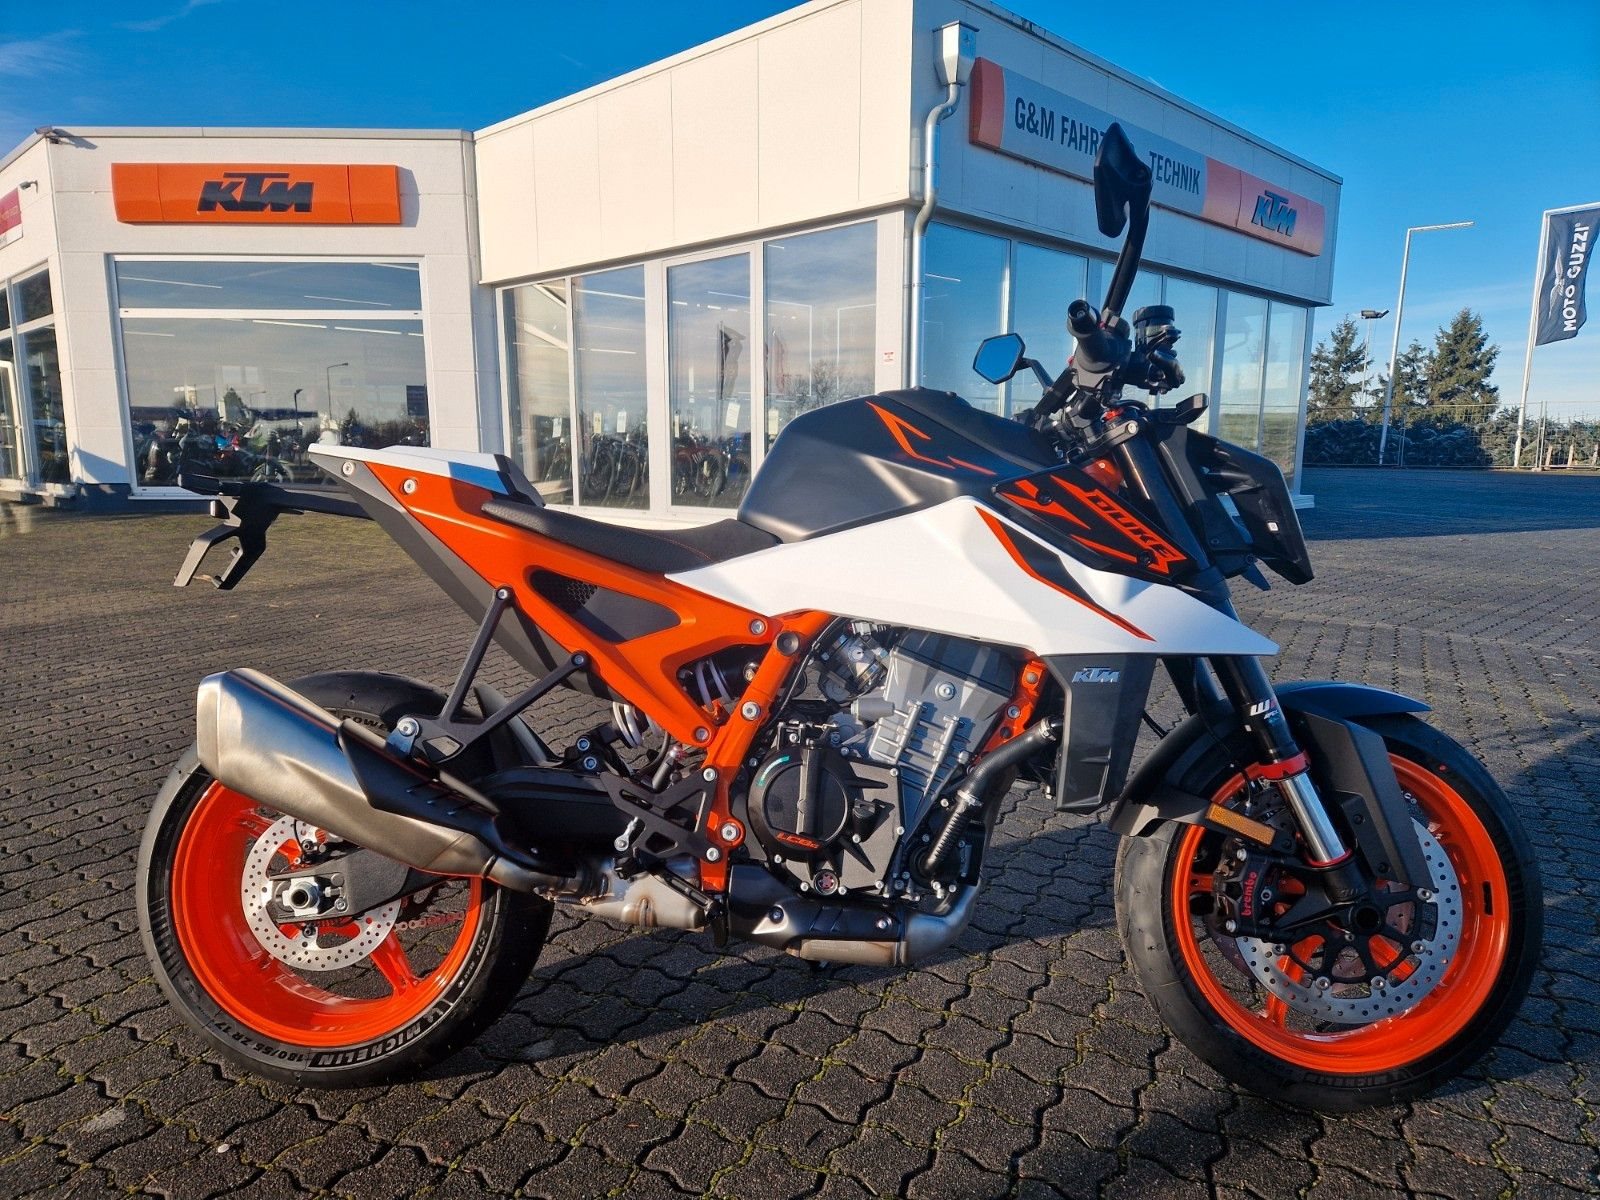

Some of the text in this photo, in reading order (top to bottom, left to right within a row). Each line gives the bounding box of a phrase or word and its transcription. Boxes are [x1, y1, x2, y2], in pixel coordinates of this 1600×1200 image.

[1015, 97, 1201, 195] G&M FAHR TECHNIK
[197, 172, 314, 213] KTM
[1251, 190, 1297, 237] KTM
[1563, 226, 1590, 332] MOTO GUZZI
[1086, 494, 1178, 558] DUKE
[1072, 667, 1120, 683] KTM
[1241, 871, 1257, 916] brembo
[214, 1020, 304, 1062] 180/55 ZR 17
[318, 1023, 422, 1067] MICHELIN
